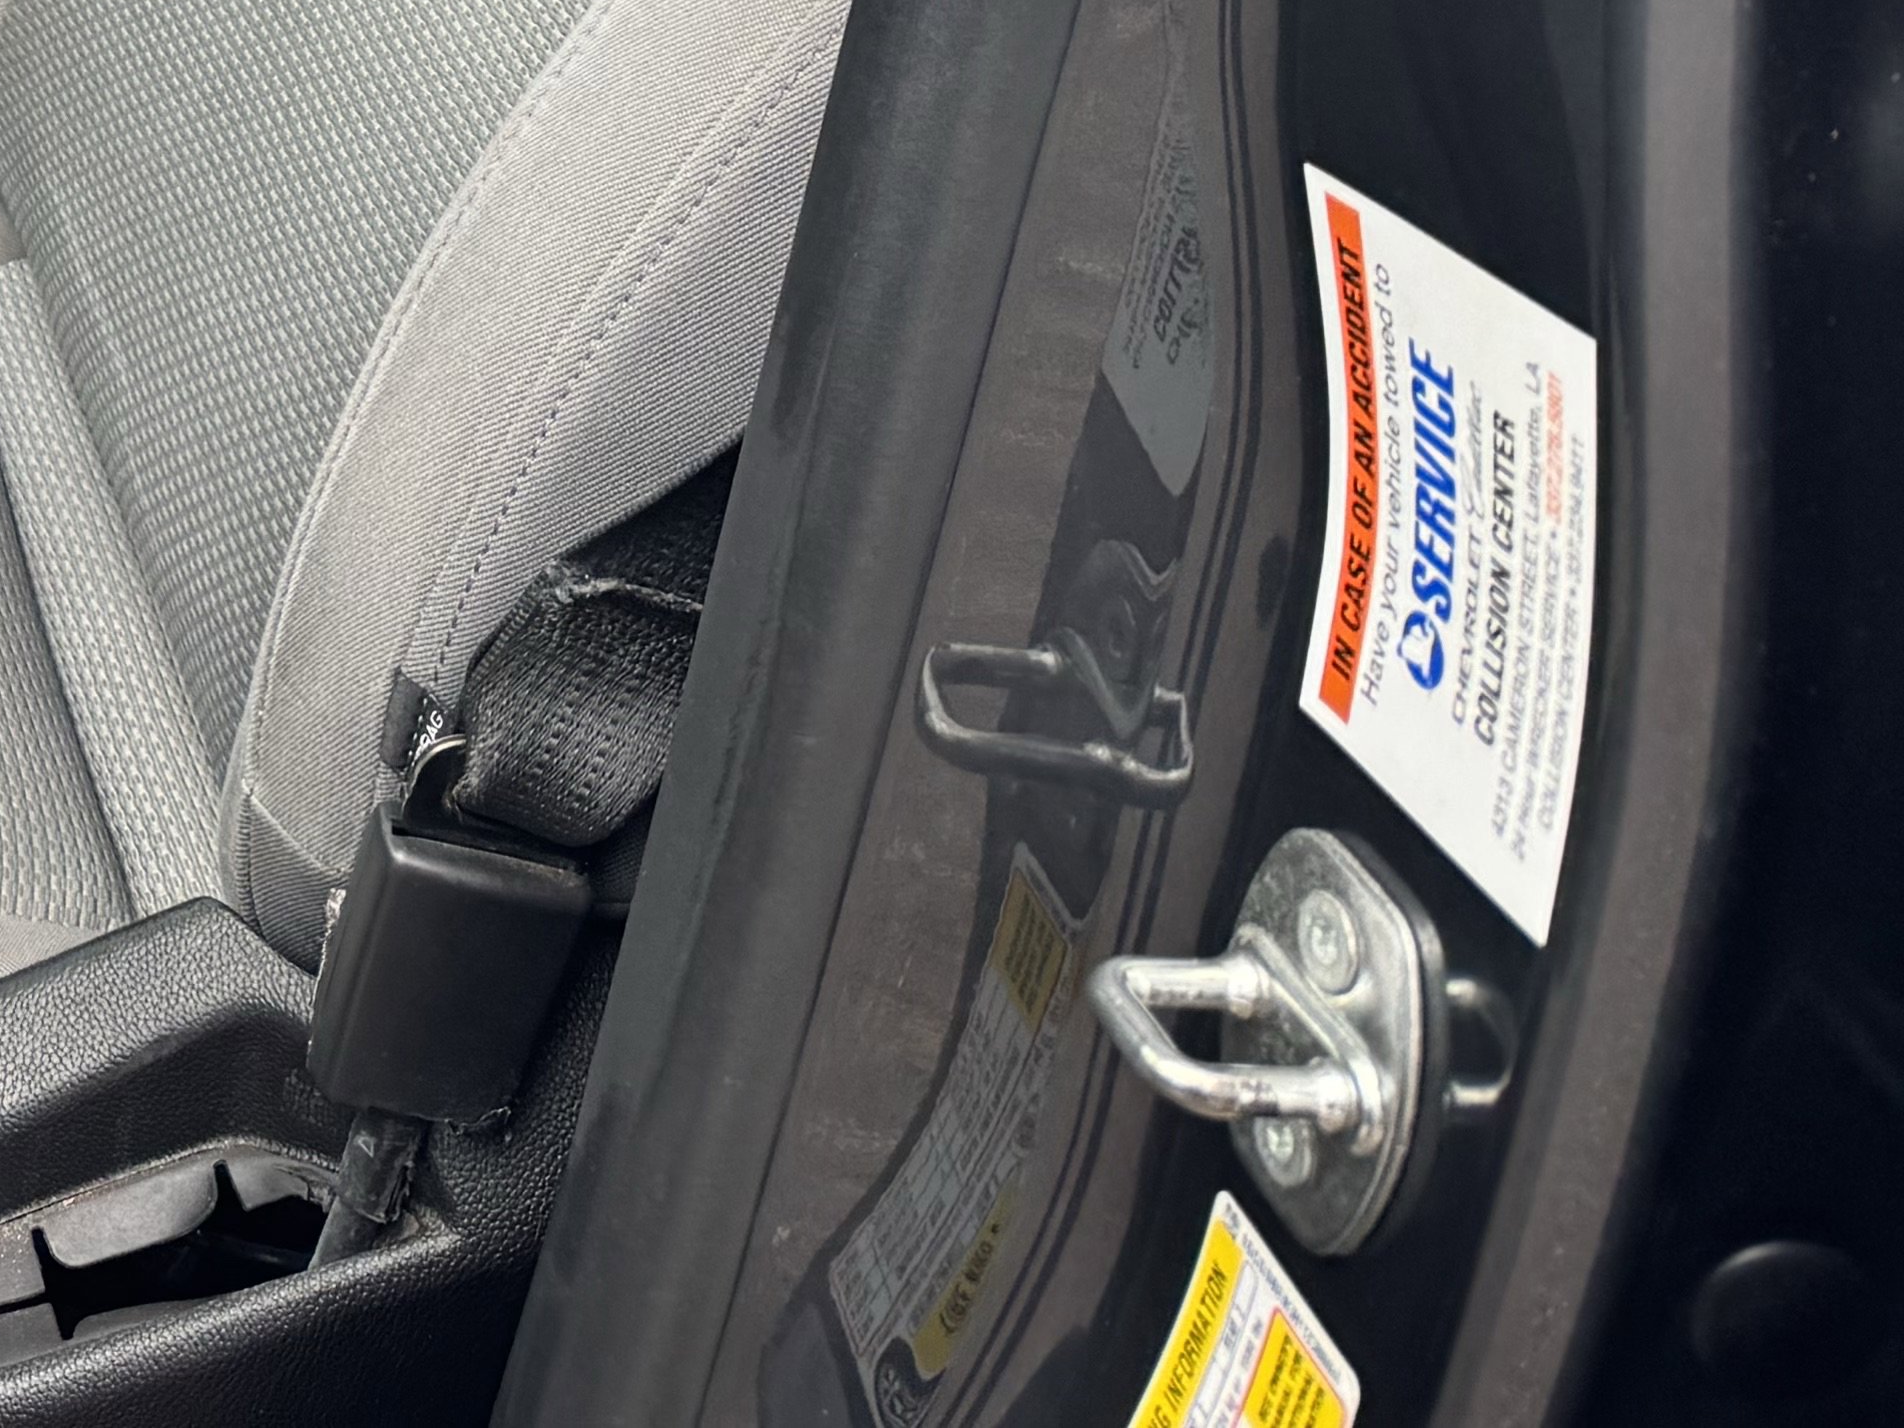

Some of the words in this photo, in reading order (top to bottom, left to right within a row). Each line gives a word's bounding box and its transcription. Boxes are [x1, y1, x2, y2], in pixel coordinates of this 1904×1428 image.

[1337, 237, 1373, 417] ACCIDENT
[1374, 263, 1391, 296] to
[1373, 299, 1398, 407] towed
[1352, 475, 1375, 530] OF
[1353, 428, 1373, 471] AN
[1383, 418, 1401, 530] vehicle
[1408, 337, 1456, 624] SERVICE
[1491, 410, 1515, 556] CENTER
[1340, 531, 1372, 632] CASE
[1380, 538, 1400, 622] your
[1452, 521, 1482, 725] CHEVROLET
[1331, 637, 1355, 681] IN
[1361, 625, 1390, 707] Have
[1474, 558, 1511, 747] COLLISION
[1501, 639, 1531, 775] CAMERON
[1163, 1260, 1229, 1409] INFORMATION
